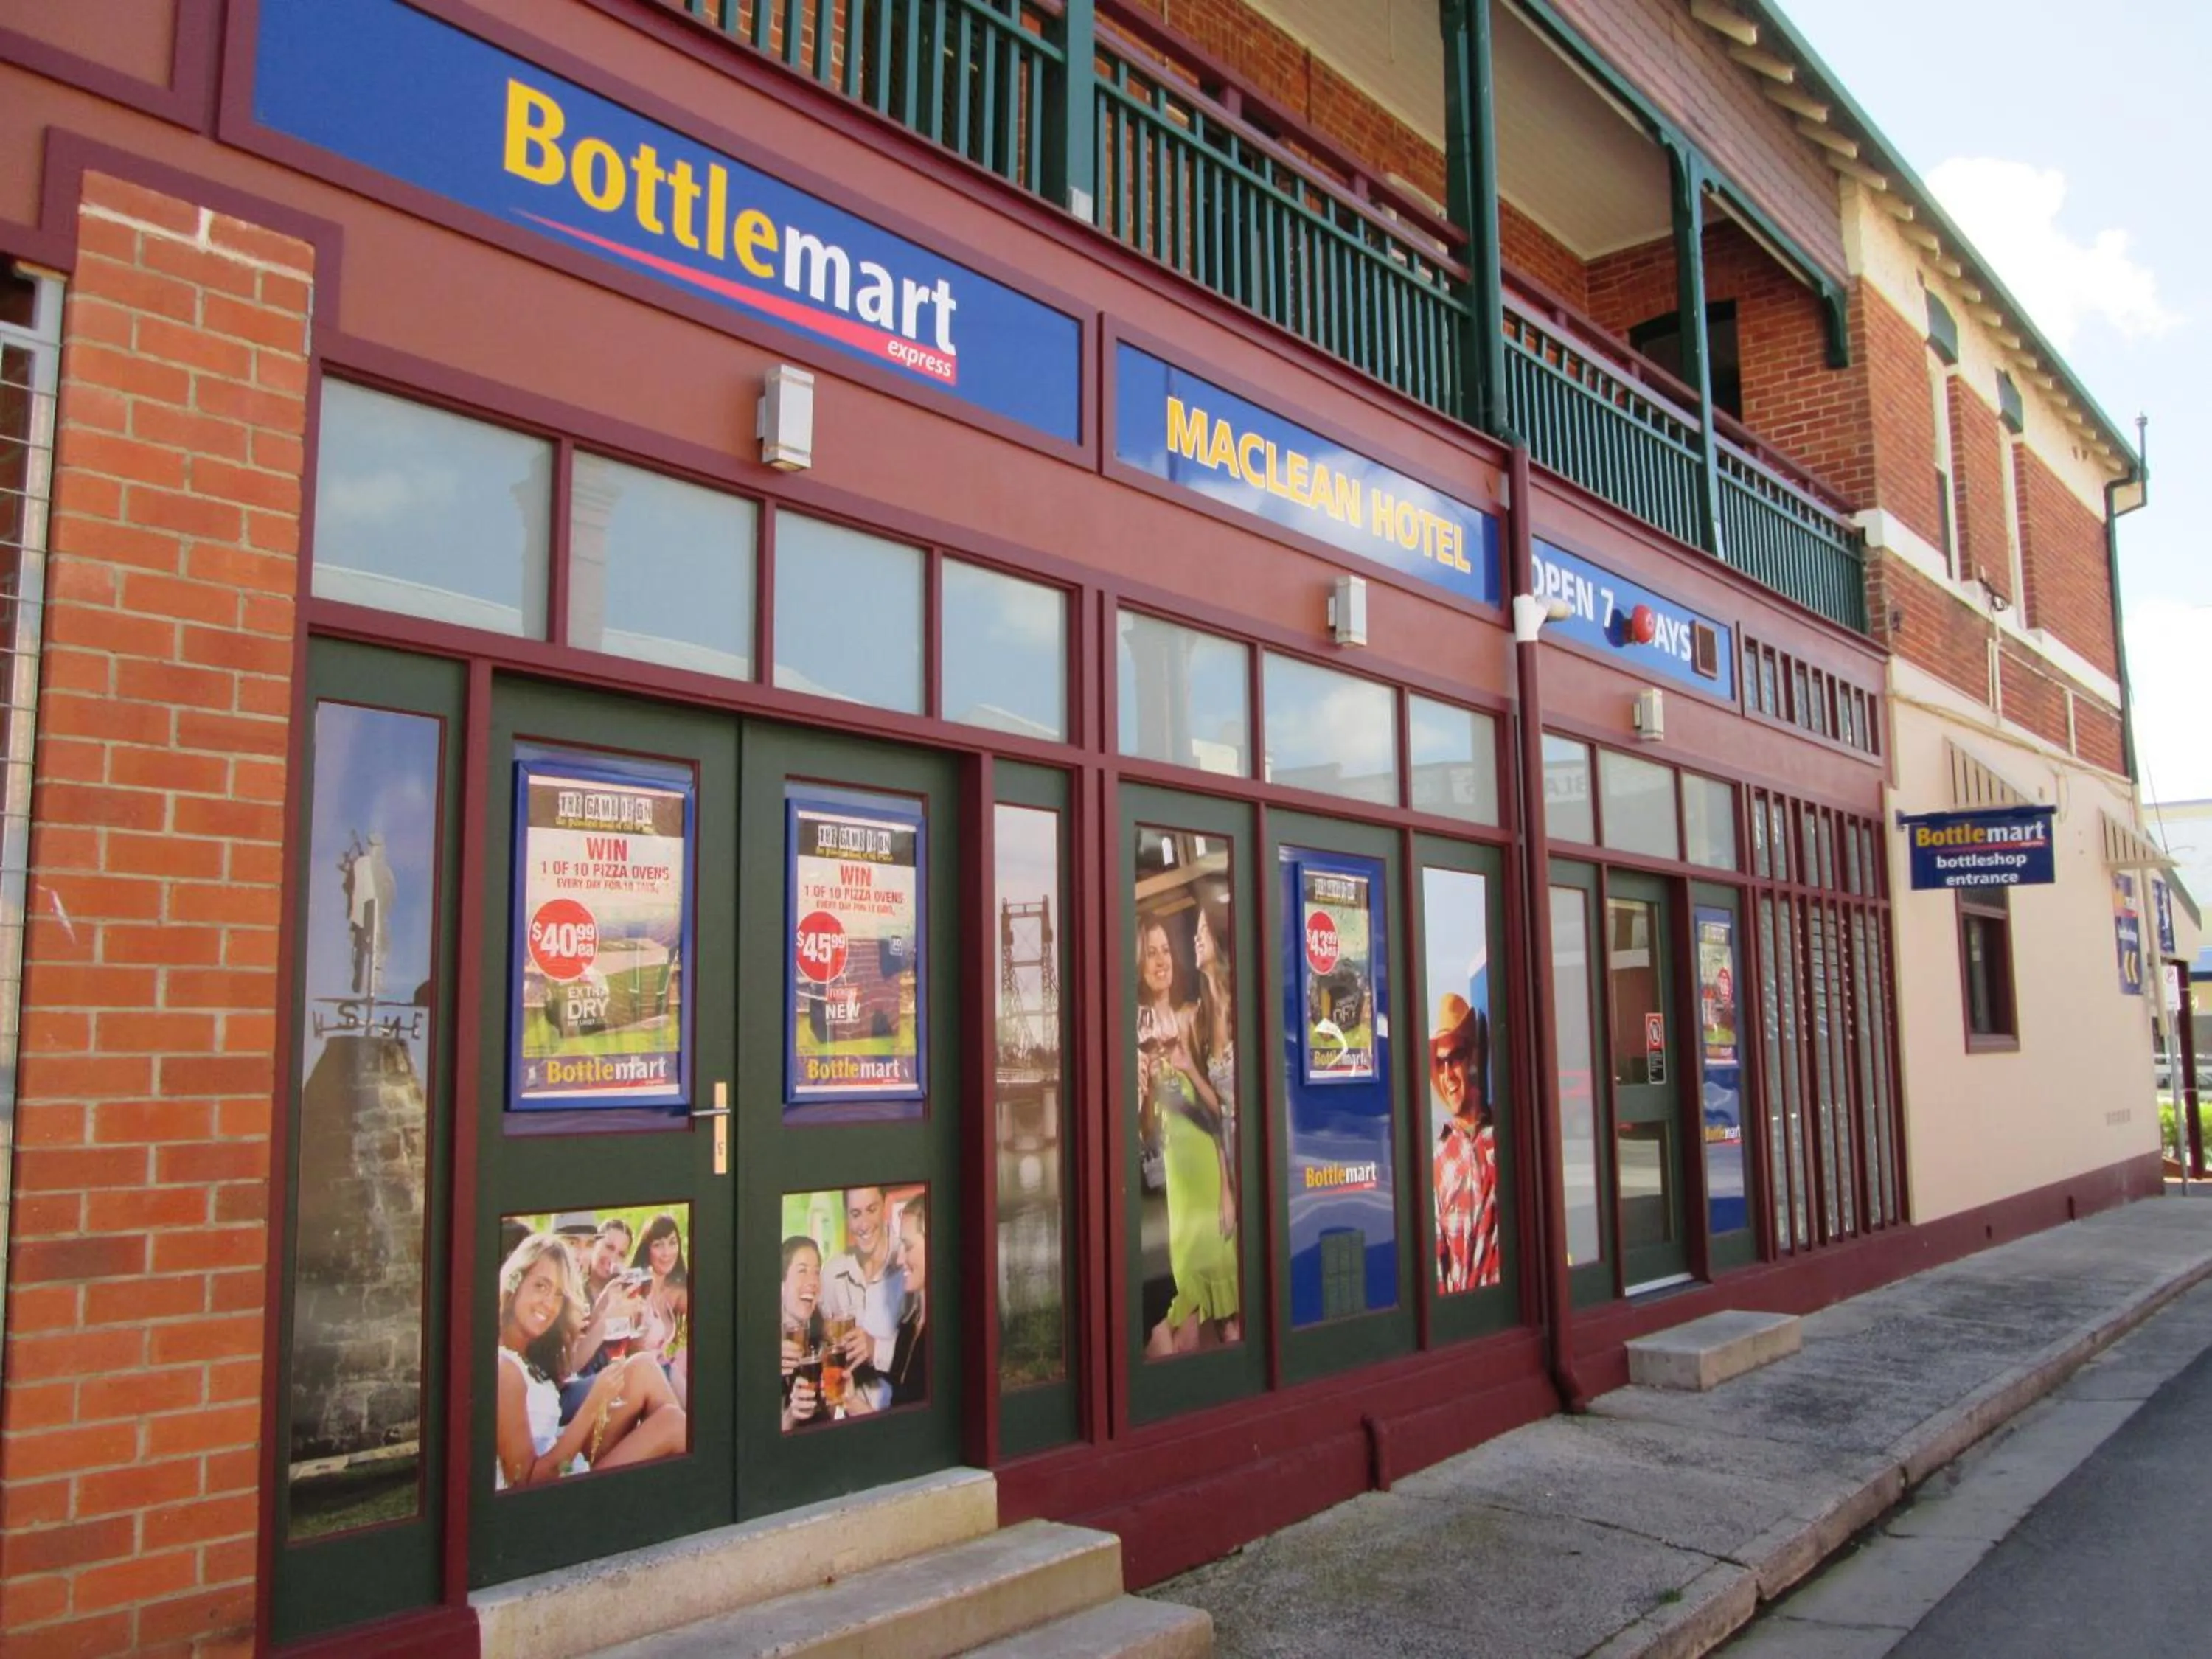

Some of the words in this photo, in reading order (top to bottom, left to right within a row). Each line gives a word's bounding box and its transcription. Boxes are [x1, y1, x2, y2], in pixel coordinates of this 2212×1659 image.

[503, 77, 956, 355] Bottlemart
[887, 336, 951, 378] express
[1166, 396, 1362, 529] MACLEAN
[1371, 487, 1471, 574] HOTEL
[1531, 553, 1593, 622] OPEN
[1601, 588, 1614, 627] 7
[1635, 612, 1691, 661] AYS
[1916, 821, 2046, 847] Bottlemart
[586, 837, 628, 861] WIN
[1935, 852, 2027, 869] bottleshop
[541, 860, 547, 874] 1
[553, 860, 569, 875] OF
[574, 862, 589, 877] 10
[593, 863, 628, 877] PIZZA
[632, 866, 669, 880] OVENS
[841, 864, 872, 886] WIN
[1945, 872, 2019, 886] entrance
[844, 887, 871, 901] PIZZA
[568, 998, 610, 1019] DRY
[825, 1002, 860, 1019] NEW
[547, 1057, 666, 1084] Bottlemart
[807, 1057, 900, 1079] Bottlemart
[1304, 1161, 1377, 1188] Bottlemart
